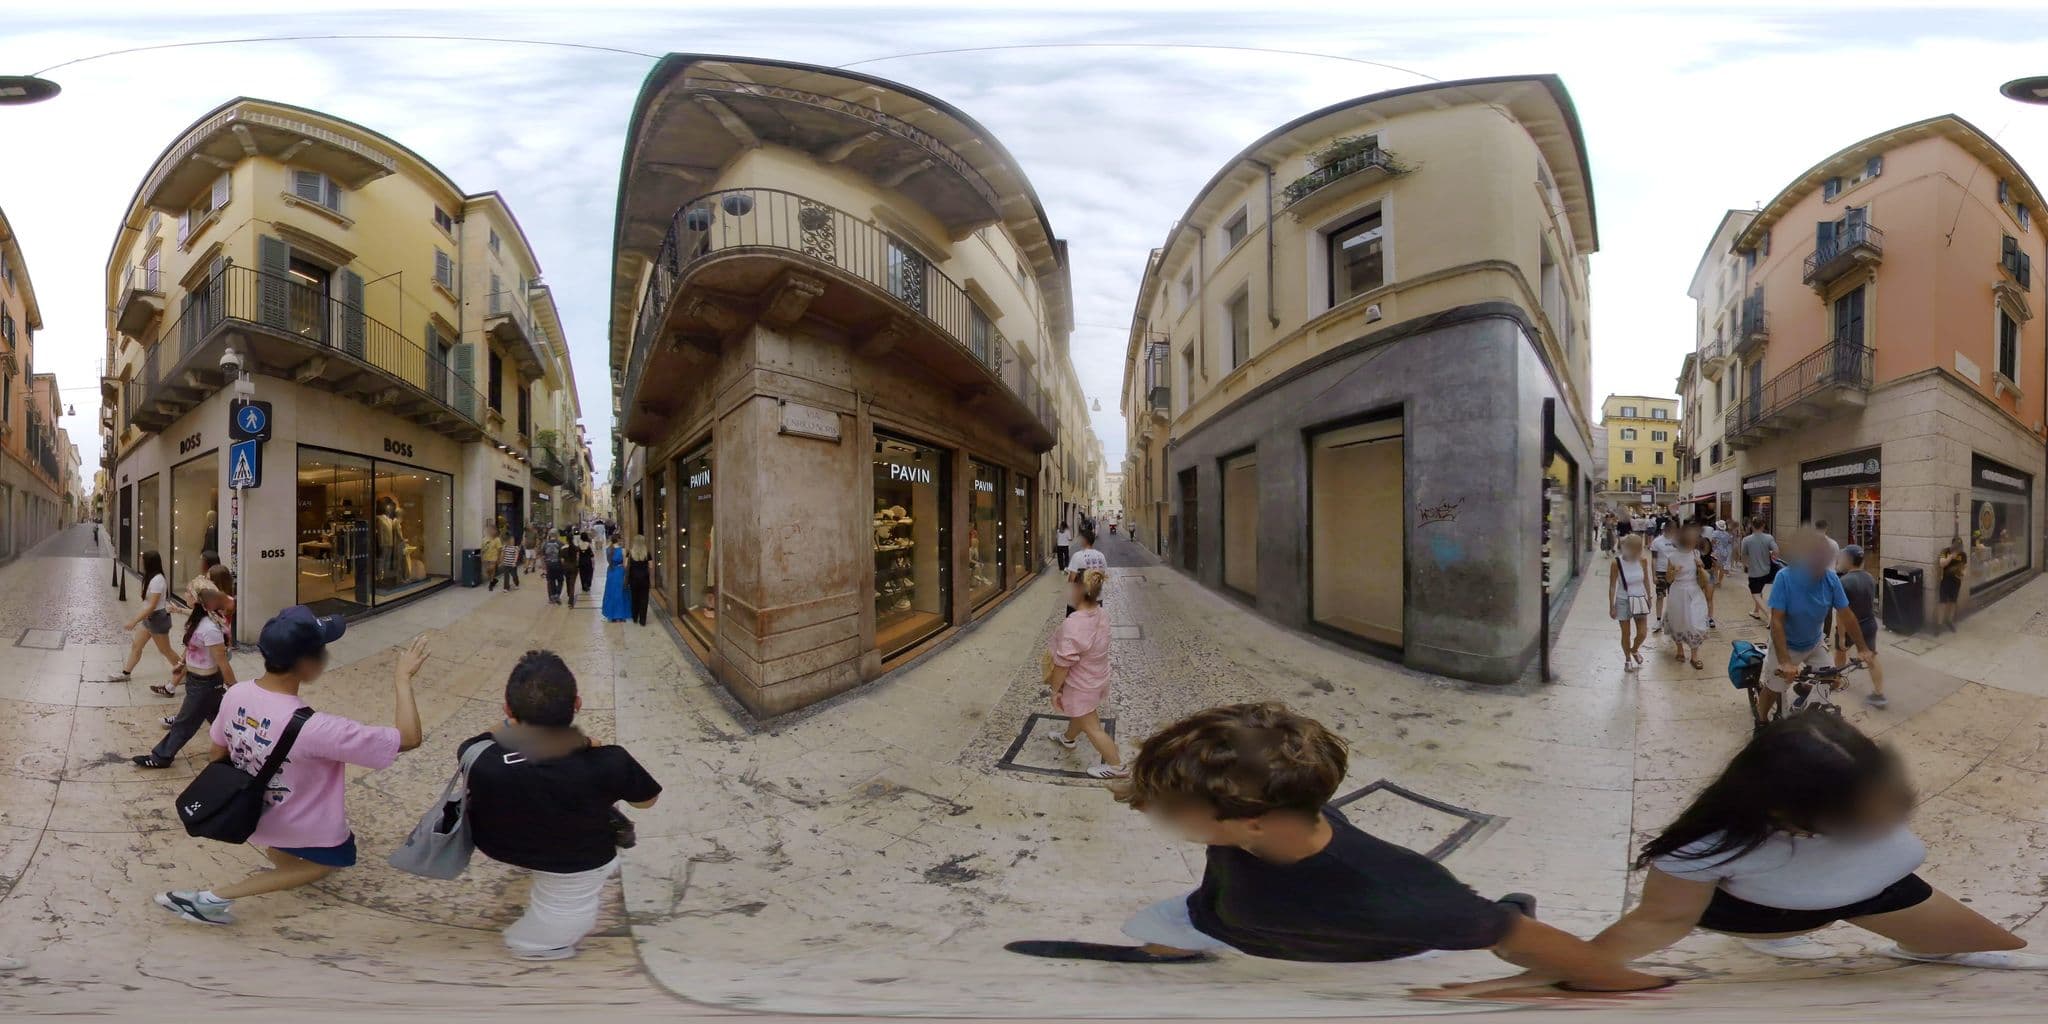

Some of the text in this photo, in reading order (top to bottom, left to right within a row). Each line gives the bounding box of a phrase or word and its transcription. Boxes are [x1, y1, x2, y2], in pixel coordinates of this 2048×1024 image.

[180, 432, 202, 455] BOSS
[384, 437, 413, 458] BOSS
[690, 469, 710, 489] PAVIN
[890, 463, 931, 484] PAVIN
[974, 479, 994, 493] PAVIN
[261, 549, 286, 559] BOSS
